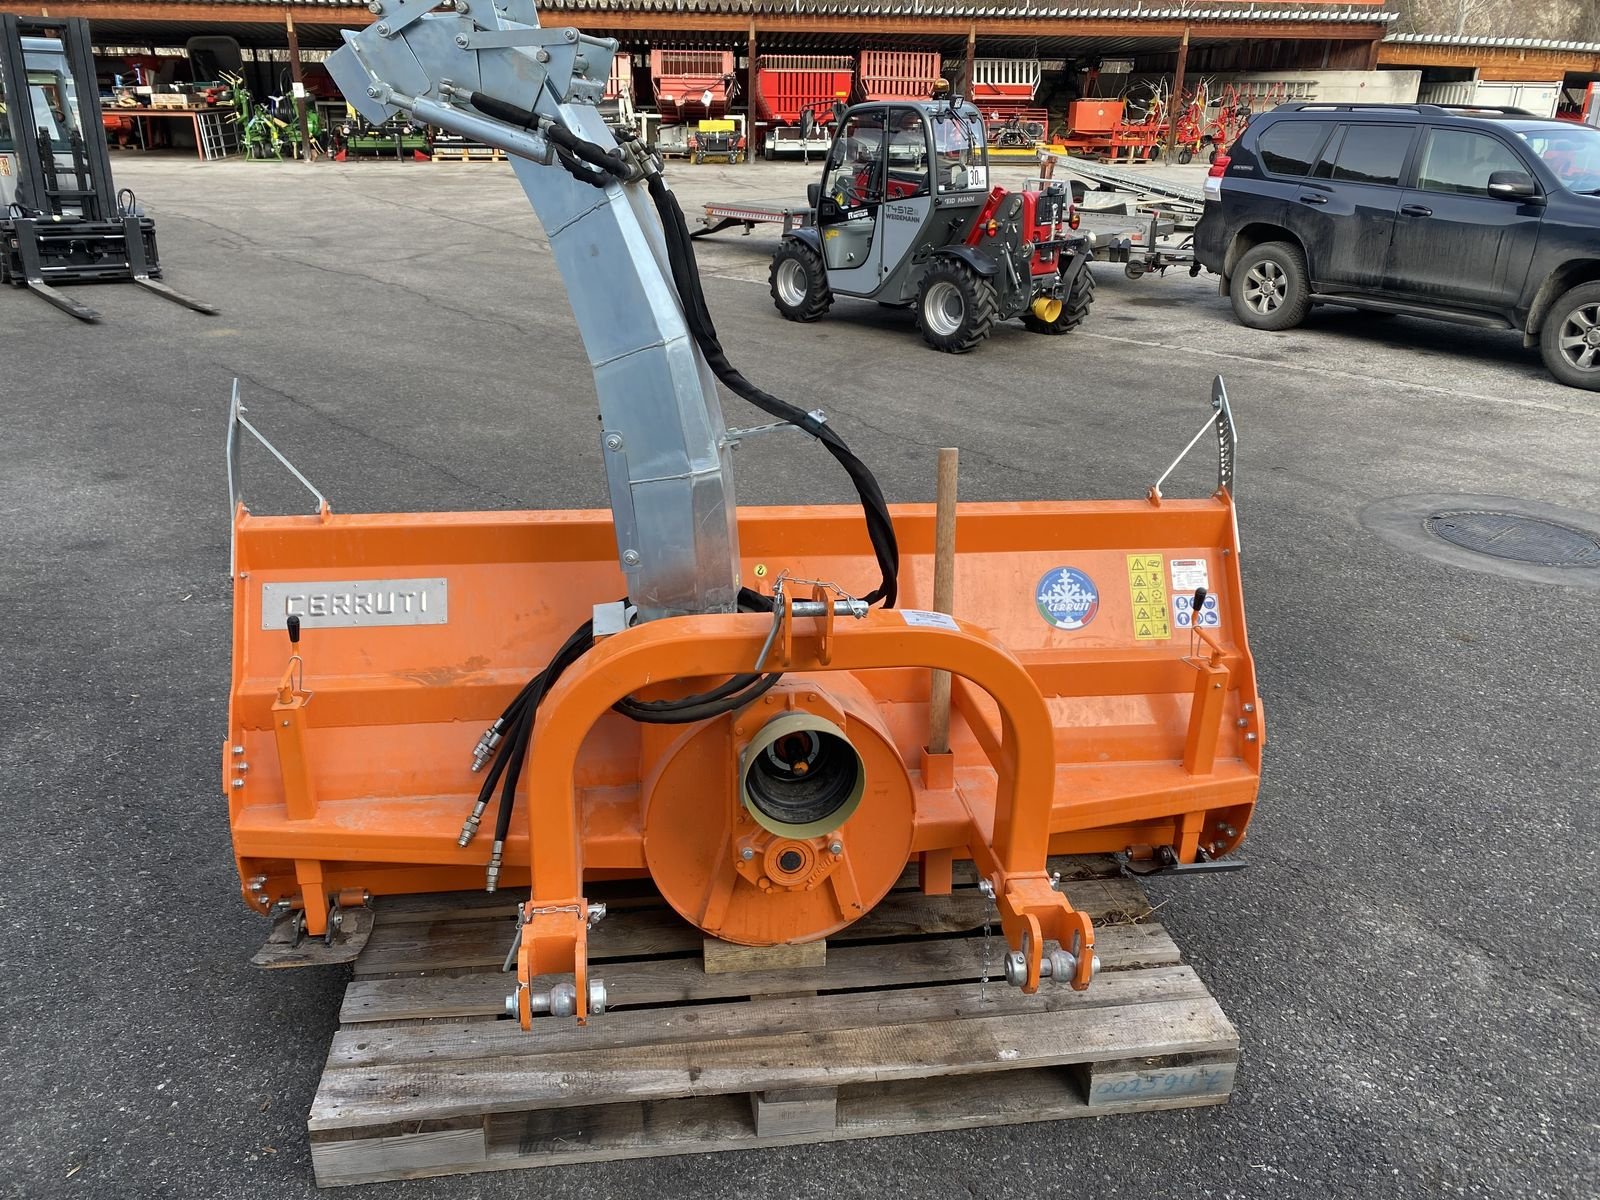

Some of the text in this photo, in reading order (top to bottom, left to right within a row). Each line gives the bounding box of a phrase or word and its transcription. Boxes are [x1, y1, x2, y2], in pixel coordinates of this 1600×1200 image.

[970, 169, 979, 186] 30
[886, 204, 914, 216] T4512
[886, 214, 920, 223] WEIDEMANN
[285, 591, 427, 617] CERRUTI
[1048, 602, 1090, 612] CERRUTI
